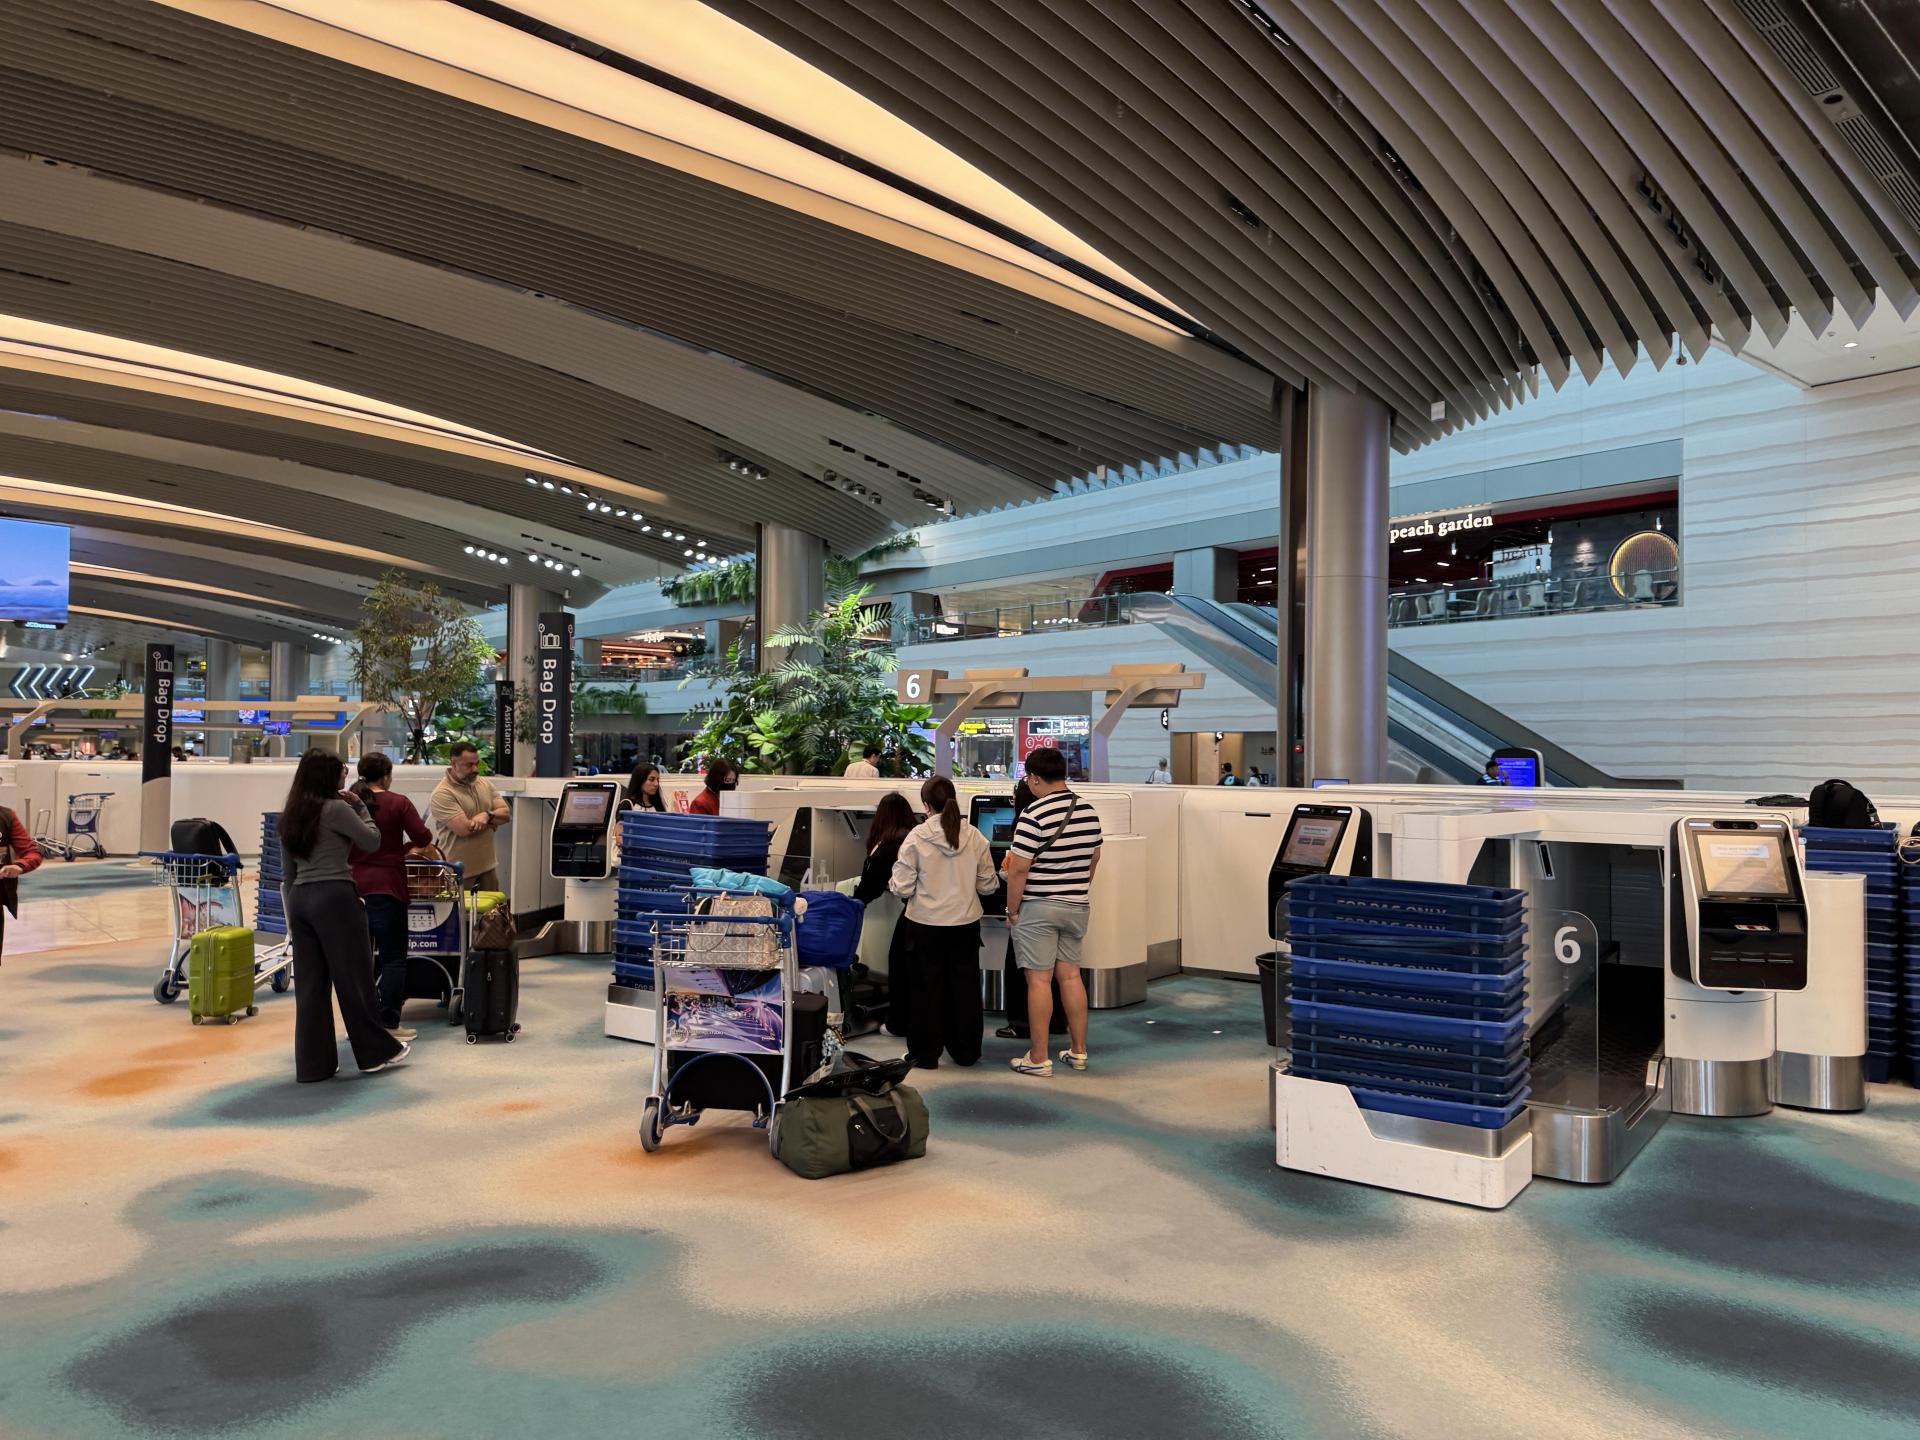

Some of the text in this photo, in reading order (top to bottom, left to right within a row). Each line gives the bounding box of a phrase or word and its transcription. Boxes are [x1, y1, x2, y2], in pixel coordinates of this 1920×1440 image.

[1390, 514, 1493, 543] peach garden
[540, 659, 557, 743] Bag Drop
[907, 674, 921, 699] 6
[153, 679, 170, 743] Bag Drop
[504, 705, 513, 754] Assistance
[408, 939, 438, 949] ip.com
[1554, 926, 1581, 964] 6
